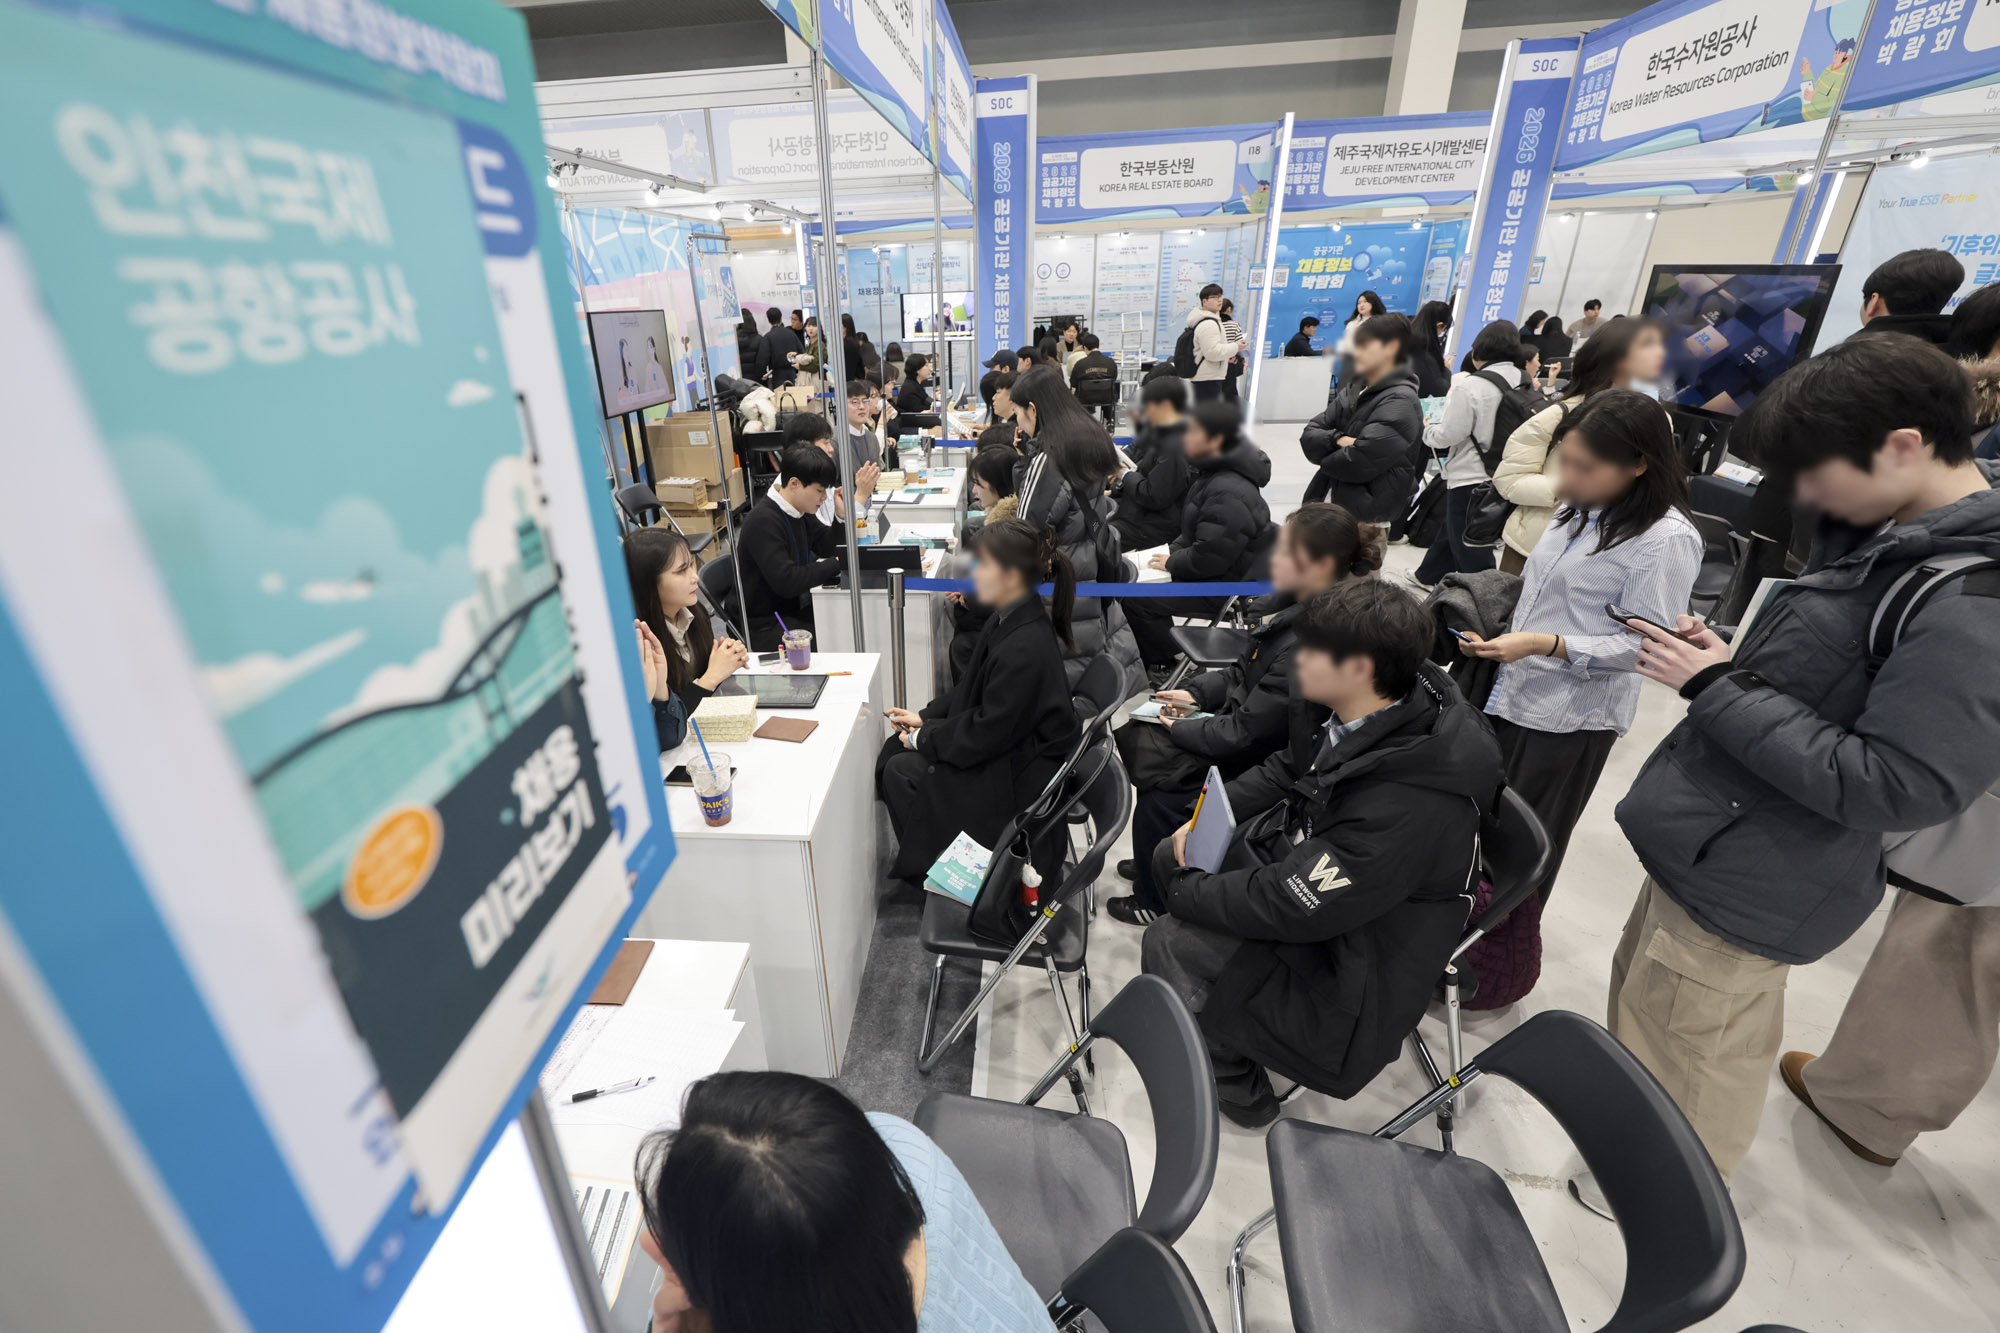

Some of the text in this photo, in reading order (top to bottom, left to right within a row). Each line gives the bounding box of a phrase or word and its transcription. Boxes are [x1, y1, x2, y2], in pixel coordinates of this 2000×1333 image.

[1884, 0, 1966, 40] 채용정보
[1647, 14, 1758, 81] 한국수자원공사
[1532, 58, 1559, 72] SOC
[1608, 50, 1789, 115] Korea Water Resources Corporation
[990, 97, 1013, 110] SOC
[1334, 138, 1488, 160] 제주국제자유도시개발센터
[58, 104, 395, 247] 인천국제
[993, 141, 1011, 194] 2026
[1120, 157, 1194, 178] 한국부동산원
[1340, 159, 1475, 174] JEJU FREE INTERNATIONAL CITY
[1355, 173, 1455, 186] DEVELOPMENT CENTER
[1042, 176, 1076, 187] 공공기관
[1042, 187, 1076, 198] 채용정보
[1099, 178, 1214, 193] KOREA REAL ESTATE BOARD
[1879, 193, 1980, 209] Your True ESG Partner
[1481, 107, 1545, 329] 2026 공공기관 채용정보
[994, 198, 1011, 270] 공공기관
[1313, 245, 1344, 256] 공공기관
[1296, 256, 1353, 274] 채용정보
[1301, 273, 1346, 290] 박람회
[116, 255, 422, 376] 공항공사
[510, 723, 581, 828] 채용
[459, 778, 596, 970] 미리보기
[1308, 852, 1352, 892] W
[1286, 877, 1316, 910] HIDEAWAY
[1291, 874, 1321, 906] LIFEWORK
